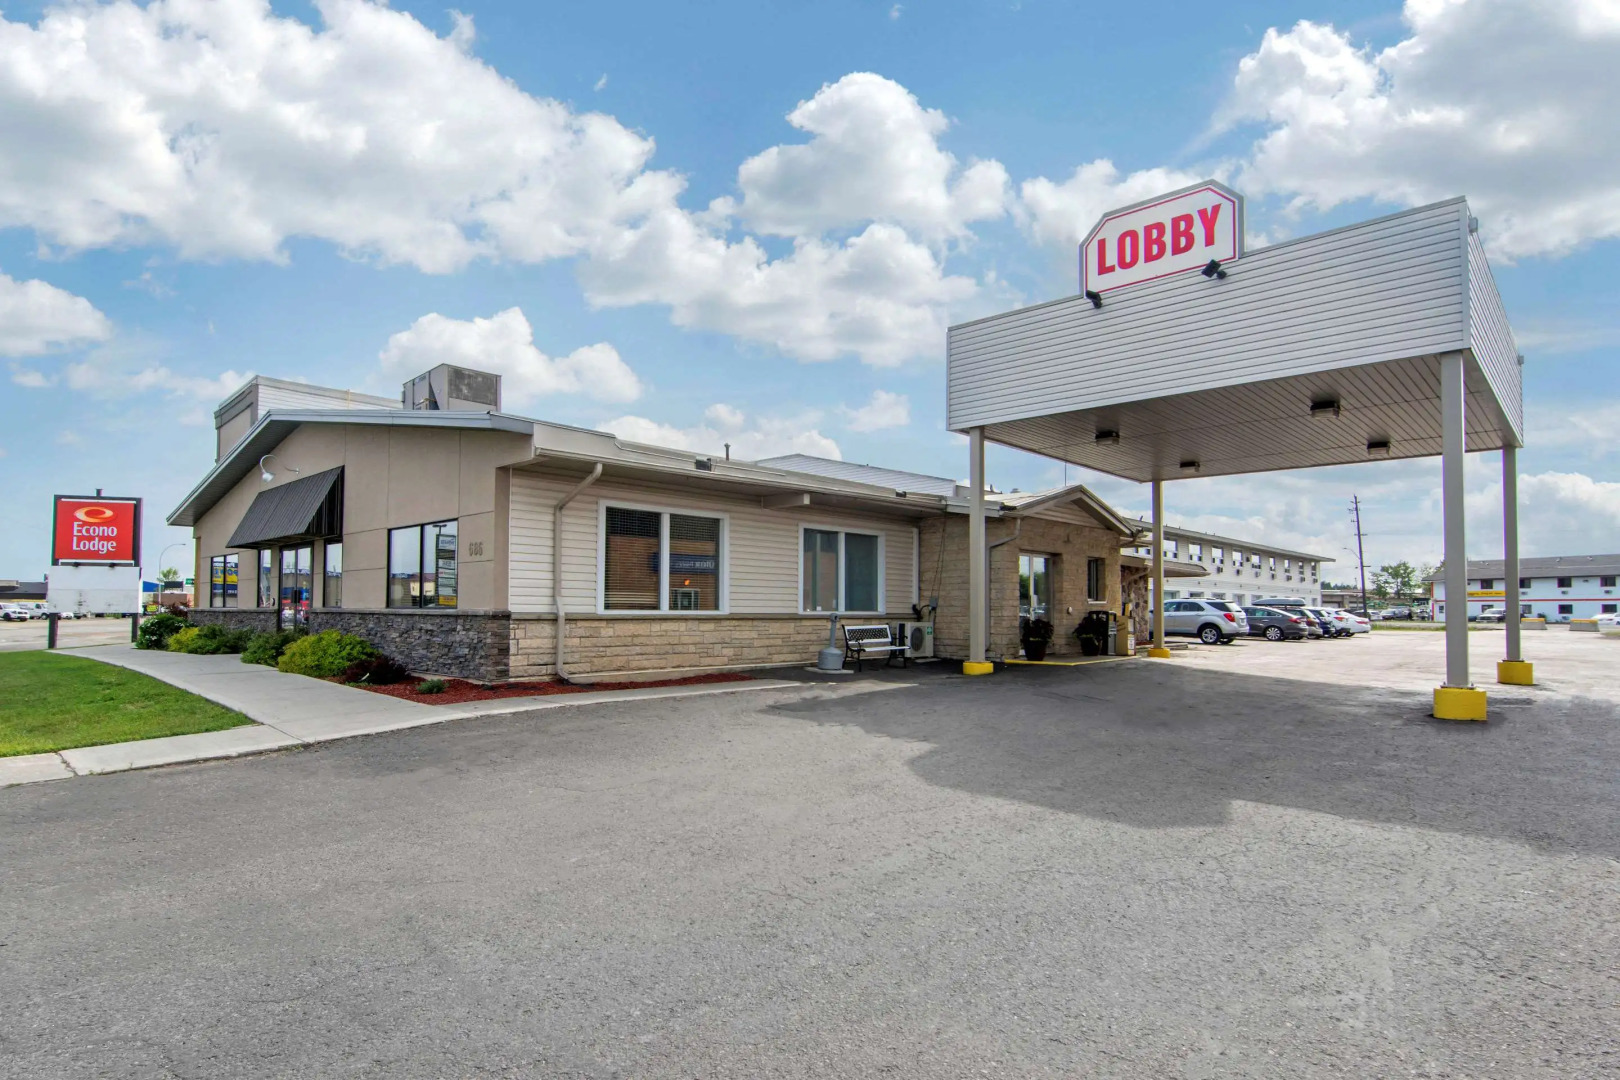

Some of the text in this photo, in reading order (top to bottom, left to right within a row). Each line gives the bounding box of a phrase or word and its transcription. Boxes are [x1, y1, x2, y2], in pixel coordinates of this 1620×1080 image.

[1097, 203, 1222, 276] LOBBY
[73, 521, 118, 537] Econo
[72, 536, 117, 554] Lodge
